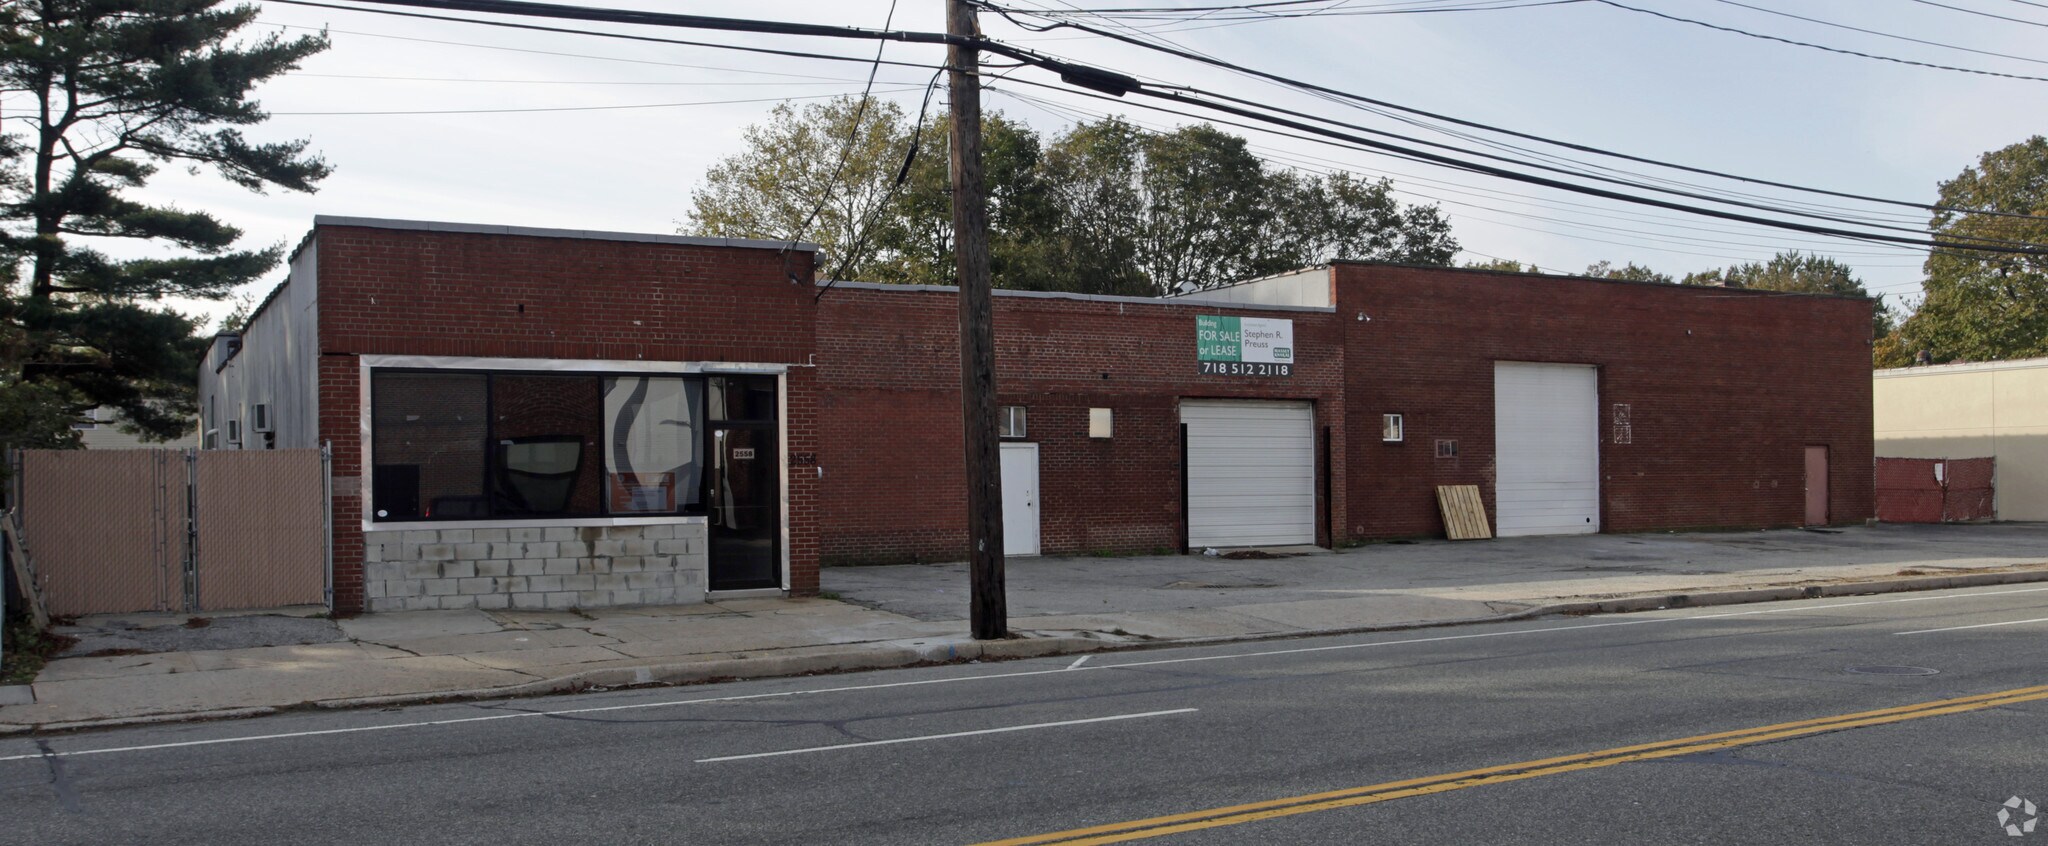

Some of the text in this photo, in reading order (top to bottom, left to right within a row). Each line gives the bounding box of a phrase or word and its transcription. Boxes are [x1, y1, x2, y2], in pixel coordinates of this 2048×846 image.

[1199, 330, 1240, 342] FOR SALE
[1244, 329, 1274, 339] Stephen
[1244, 340, 1269, 348] Preuss
[1200, 345, 1237, 356] or LEASE
[1204, 362, 1288, 375] 718 512 2118
